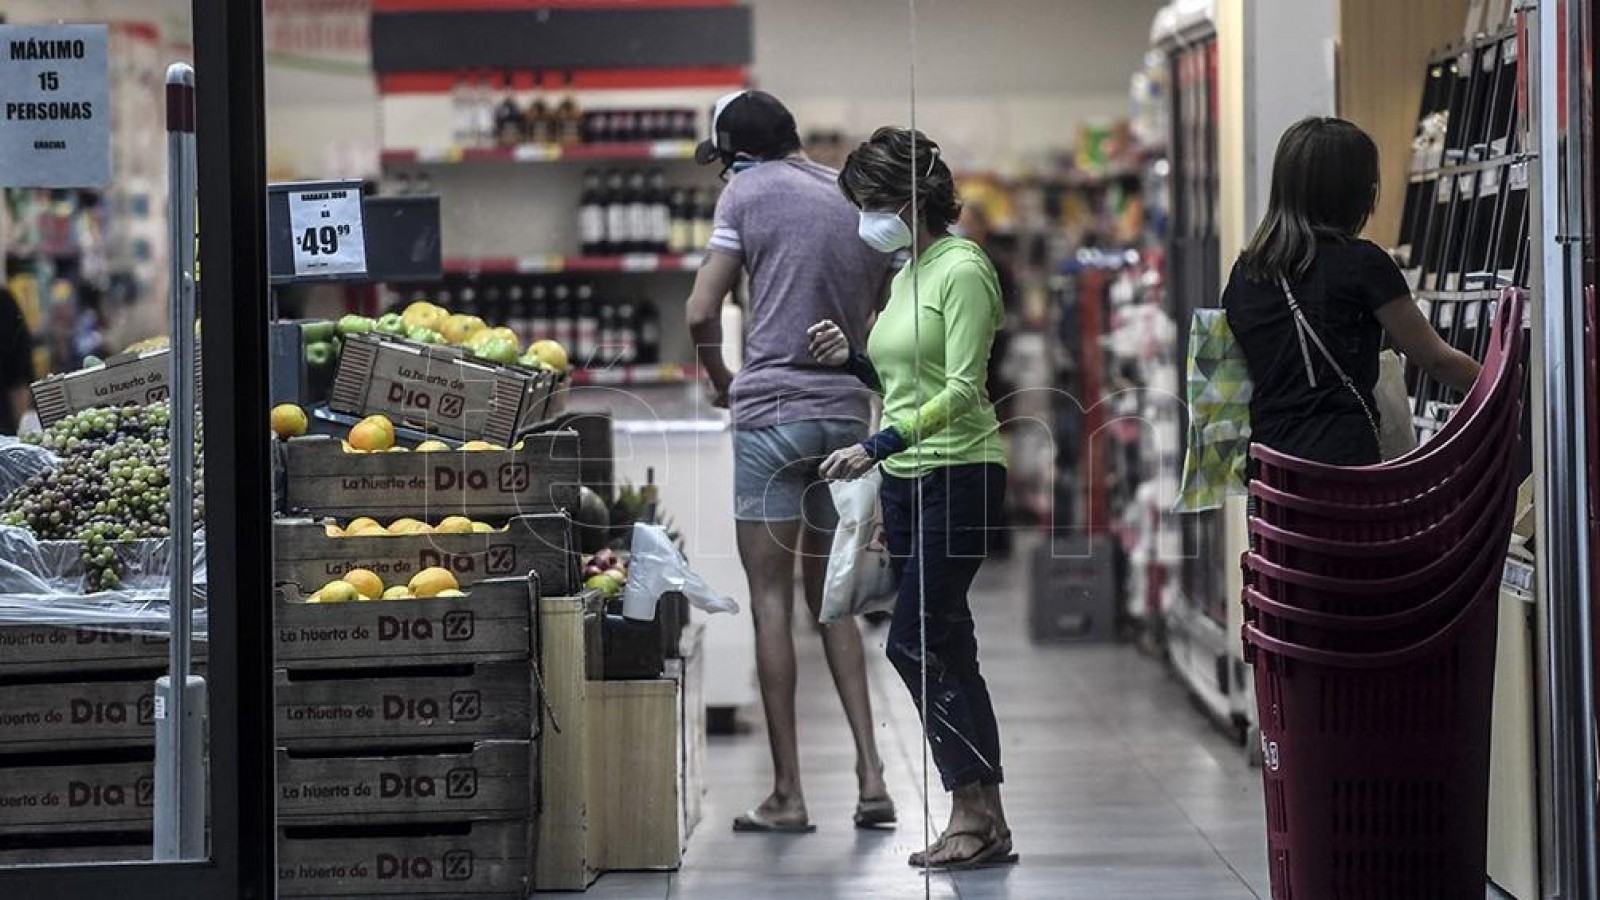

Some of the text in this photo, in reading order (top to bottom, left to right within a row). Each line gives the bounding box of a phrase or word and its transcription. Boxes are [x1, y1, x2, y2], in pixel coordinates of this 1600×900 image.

[10, 37, 84, 60] MÁXIMO
[38, 71, 59, 91] 15
[6, 101, 92, 121] PERSONAS
[398, 366, 410, 379] La
[109, 376, 145, 392] huerta
[148, 371, 162, 382] de
[342, 477, 358, 490] La
[361, 476, 405, 490] huerta
[408, 476, 426, 489] de
[325, 562, 341, 575] La
[393, 559, 412, 573] de
[49, 629, 67, 644] de
[280, 629, 297, 643] La
[300, 627, 347, 642] huerta
[351, 626, 369, 640] de
[44, 709, 63, 724] de
[286, 708, 303, 721] La
[307, 706, 353, 720] huerta
[356, 705, 373, 719] de
[282, 785, 299, 799] La
[302, 784, 349, 799] huerta
[352, 782, 371, 797] de
[40, 791, 60, 807] de
[299, 864, 346, 879] huerta
[349, 862, 368, 878] de
